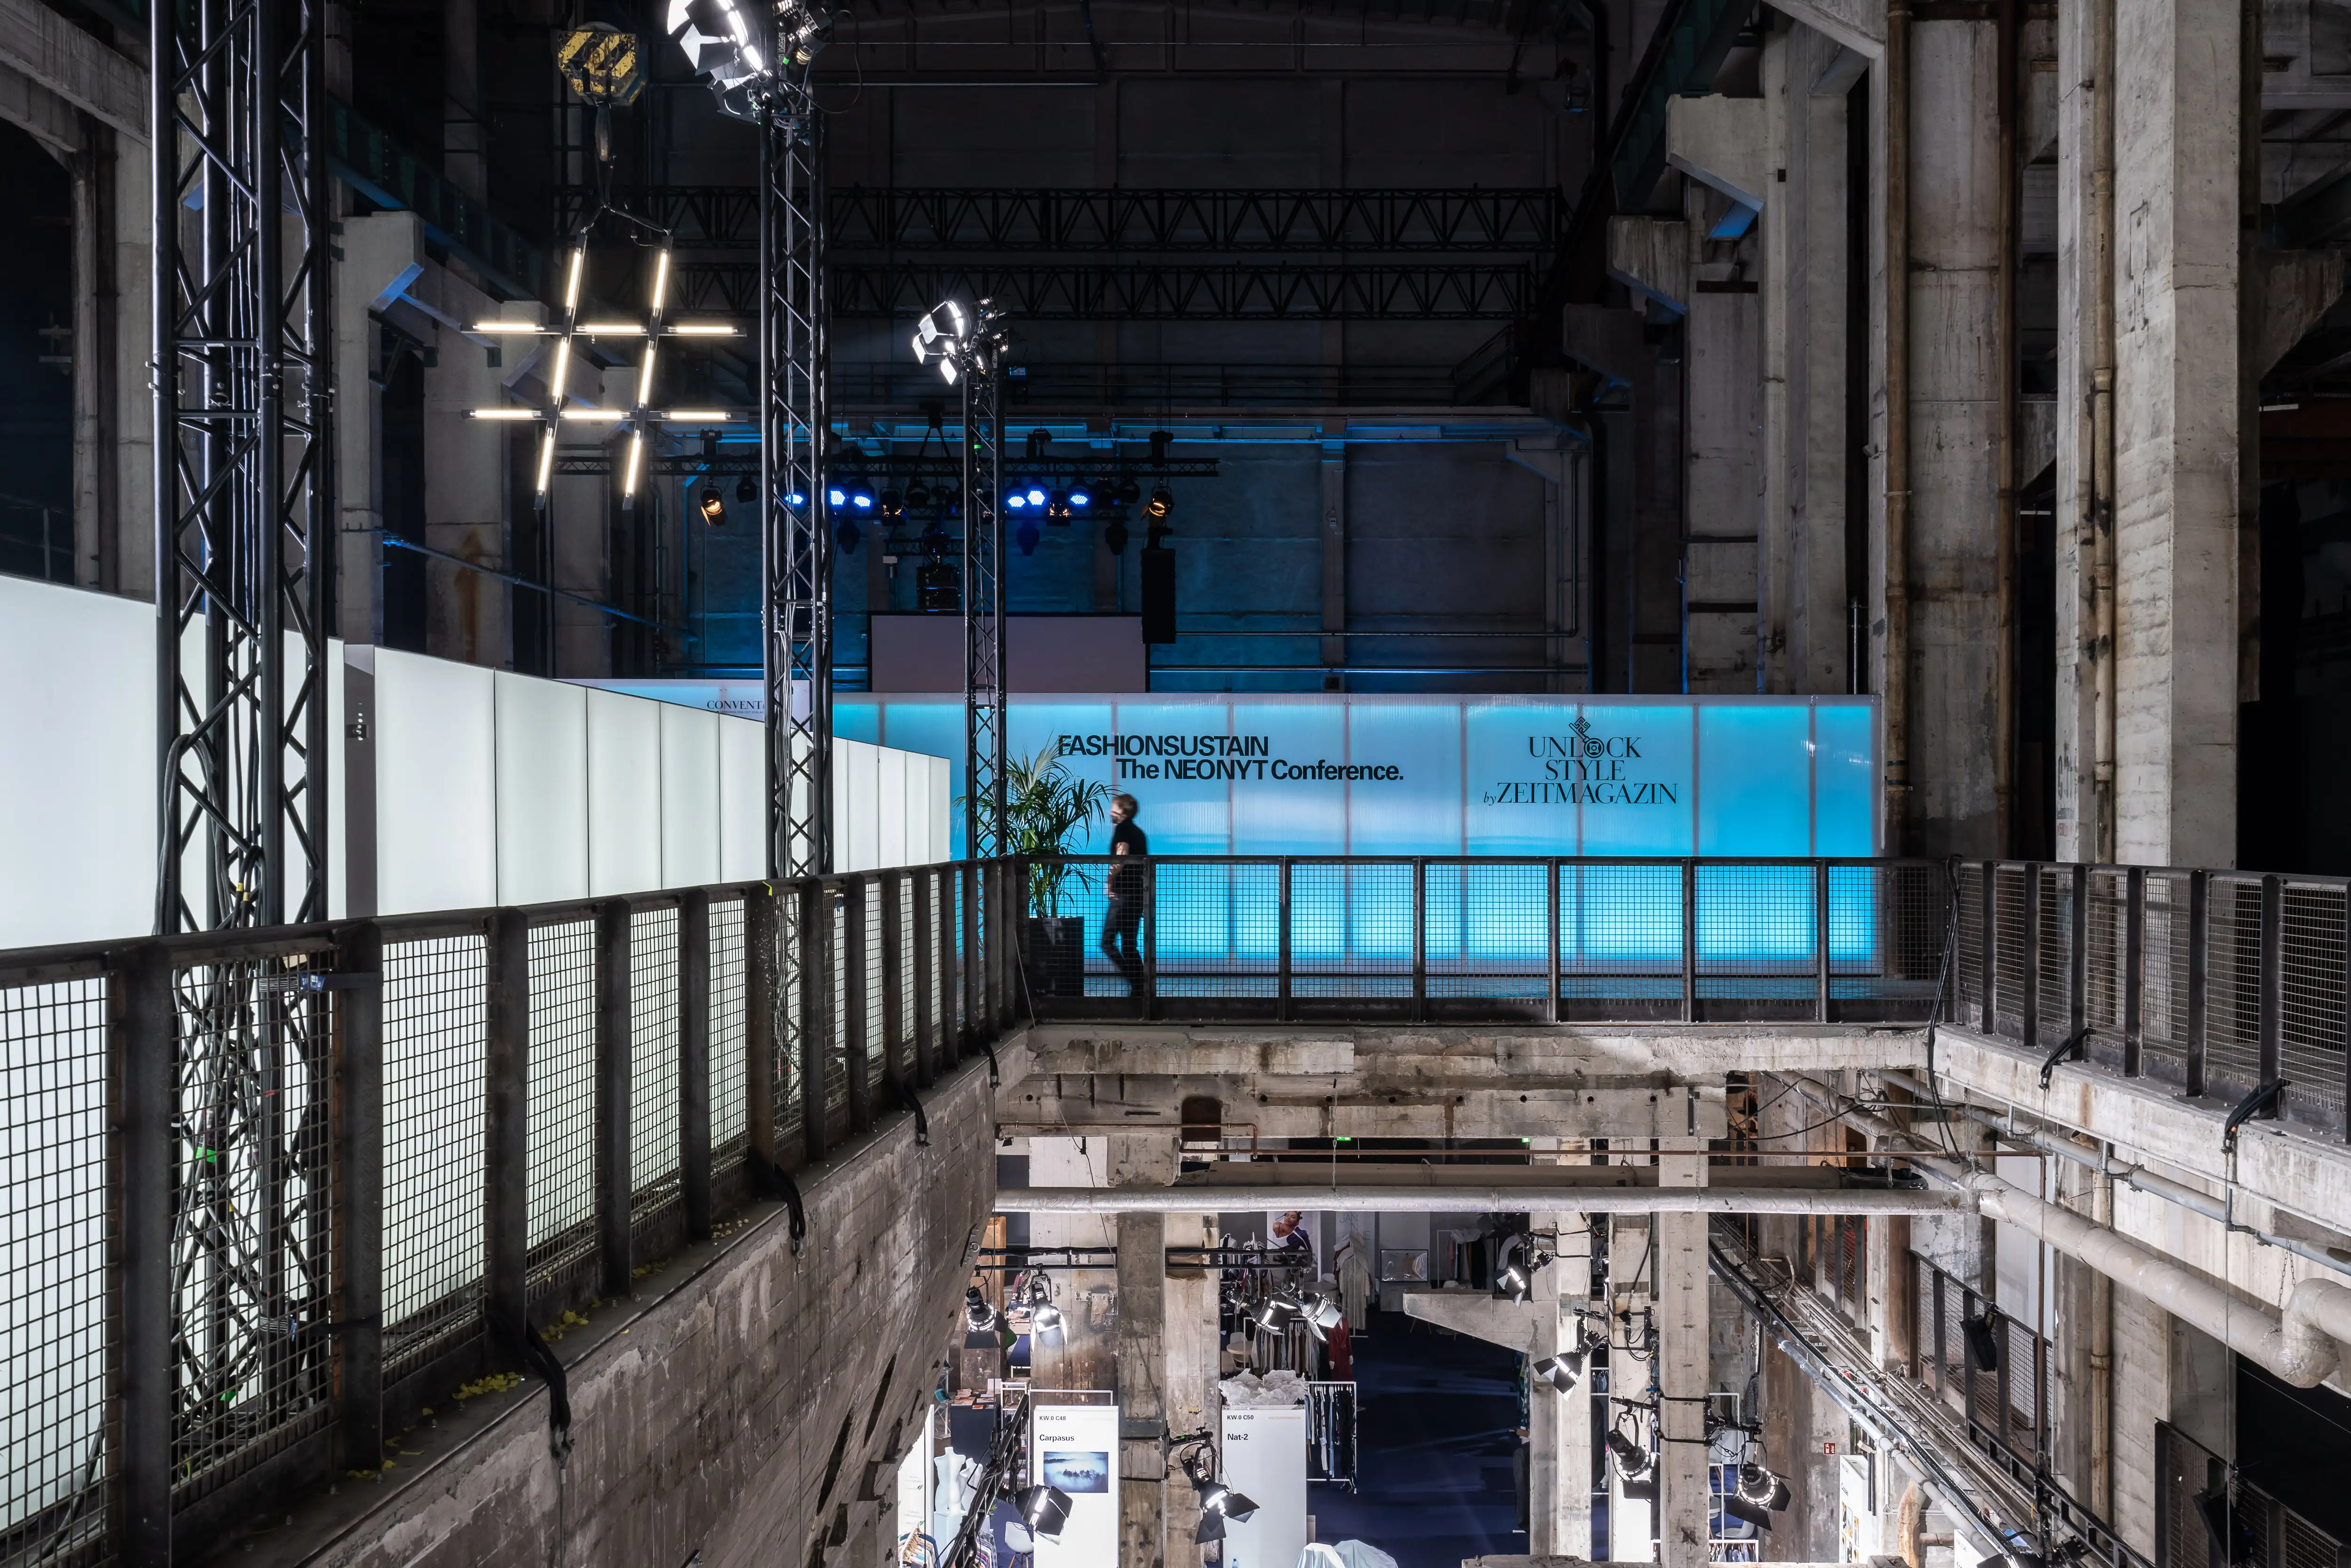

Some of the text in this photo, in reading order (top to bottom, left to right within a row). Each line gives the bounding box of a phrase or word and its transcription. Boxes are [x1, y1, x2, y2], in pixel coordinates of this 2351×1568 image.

[707, 700, 763, 709] CONVENT
[1058, 735, 1269, 756] FASHIONSUSTAIN
[1116, 758, 1404, 780] The NEONYT Conference.
[1545, 759, 1626, 781] STYLE
[1039, 1434, 1075, 1442] Carpasus
